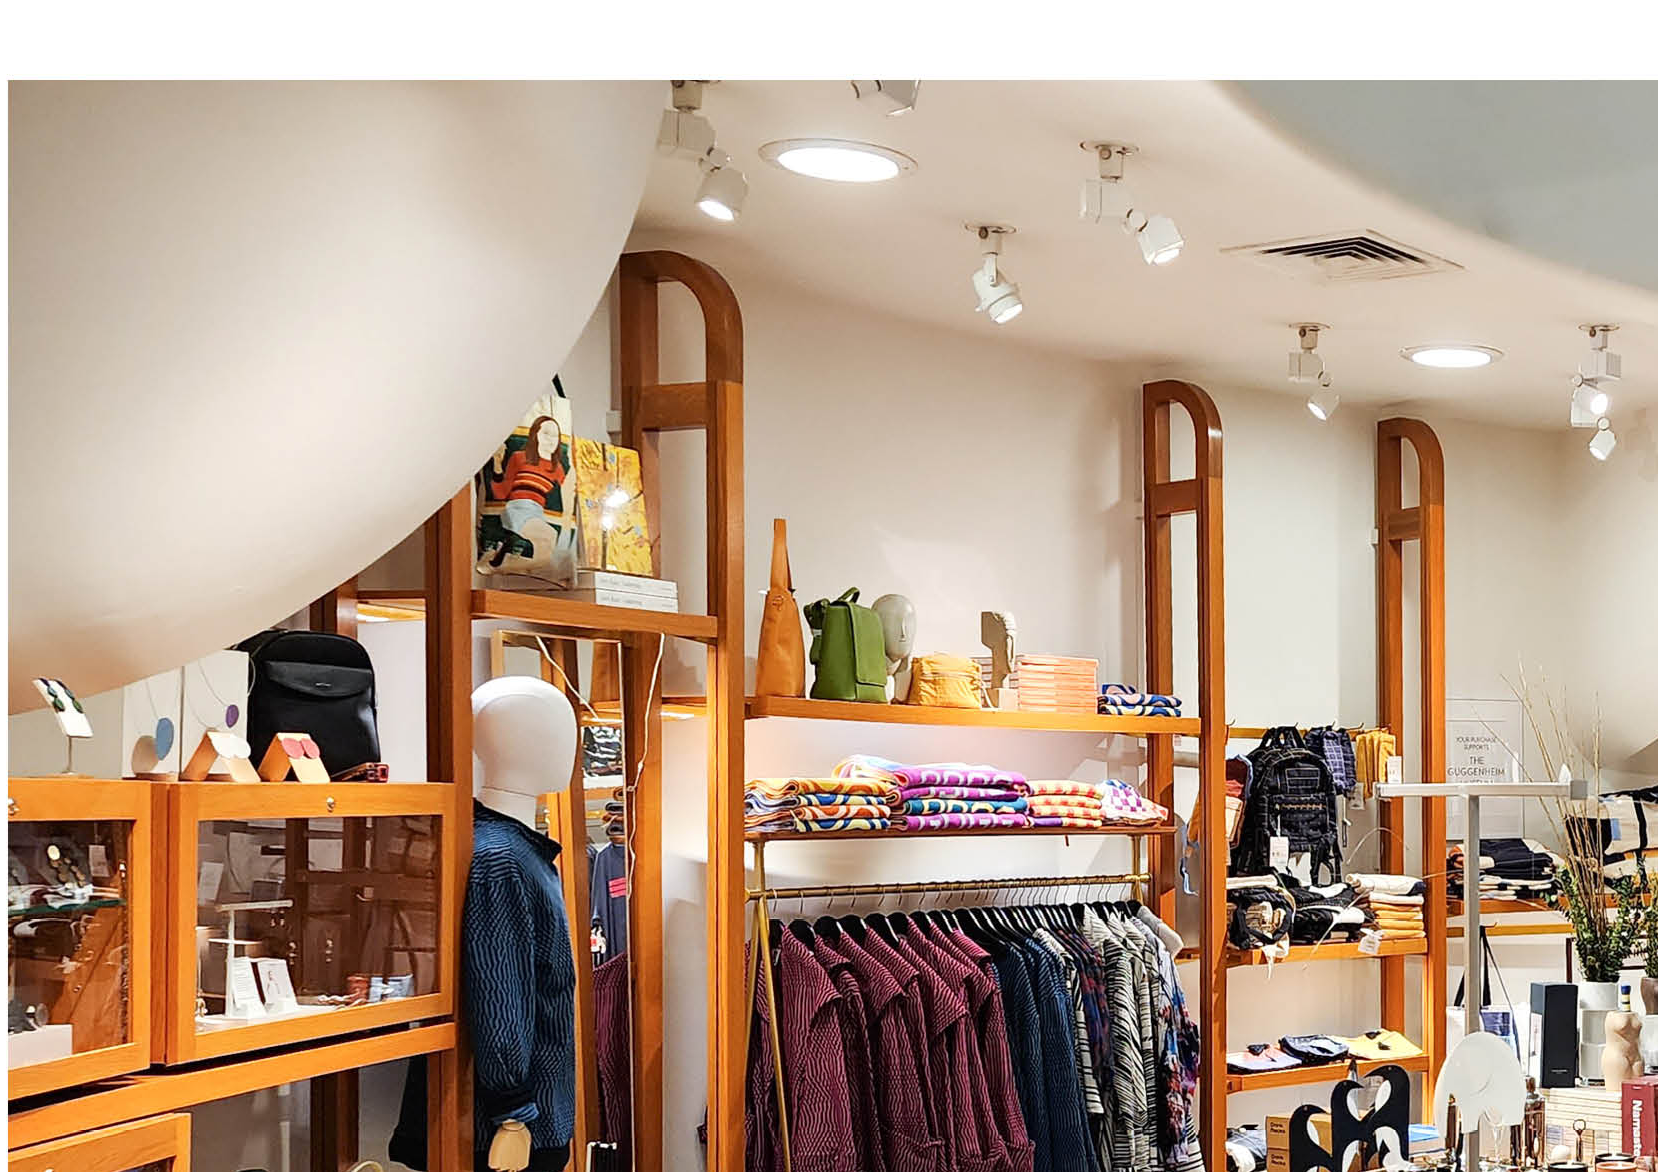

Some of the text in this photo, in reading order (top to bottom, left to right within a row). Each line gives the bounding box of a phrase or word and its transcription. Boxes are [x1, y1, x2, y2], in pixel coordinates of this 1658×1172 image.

[1469, 755, 1485, 765] THE
[1447, 767, 1506, 777] GUGGENHEIM
[1632, 1099, 1643, 1157] Namaste
